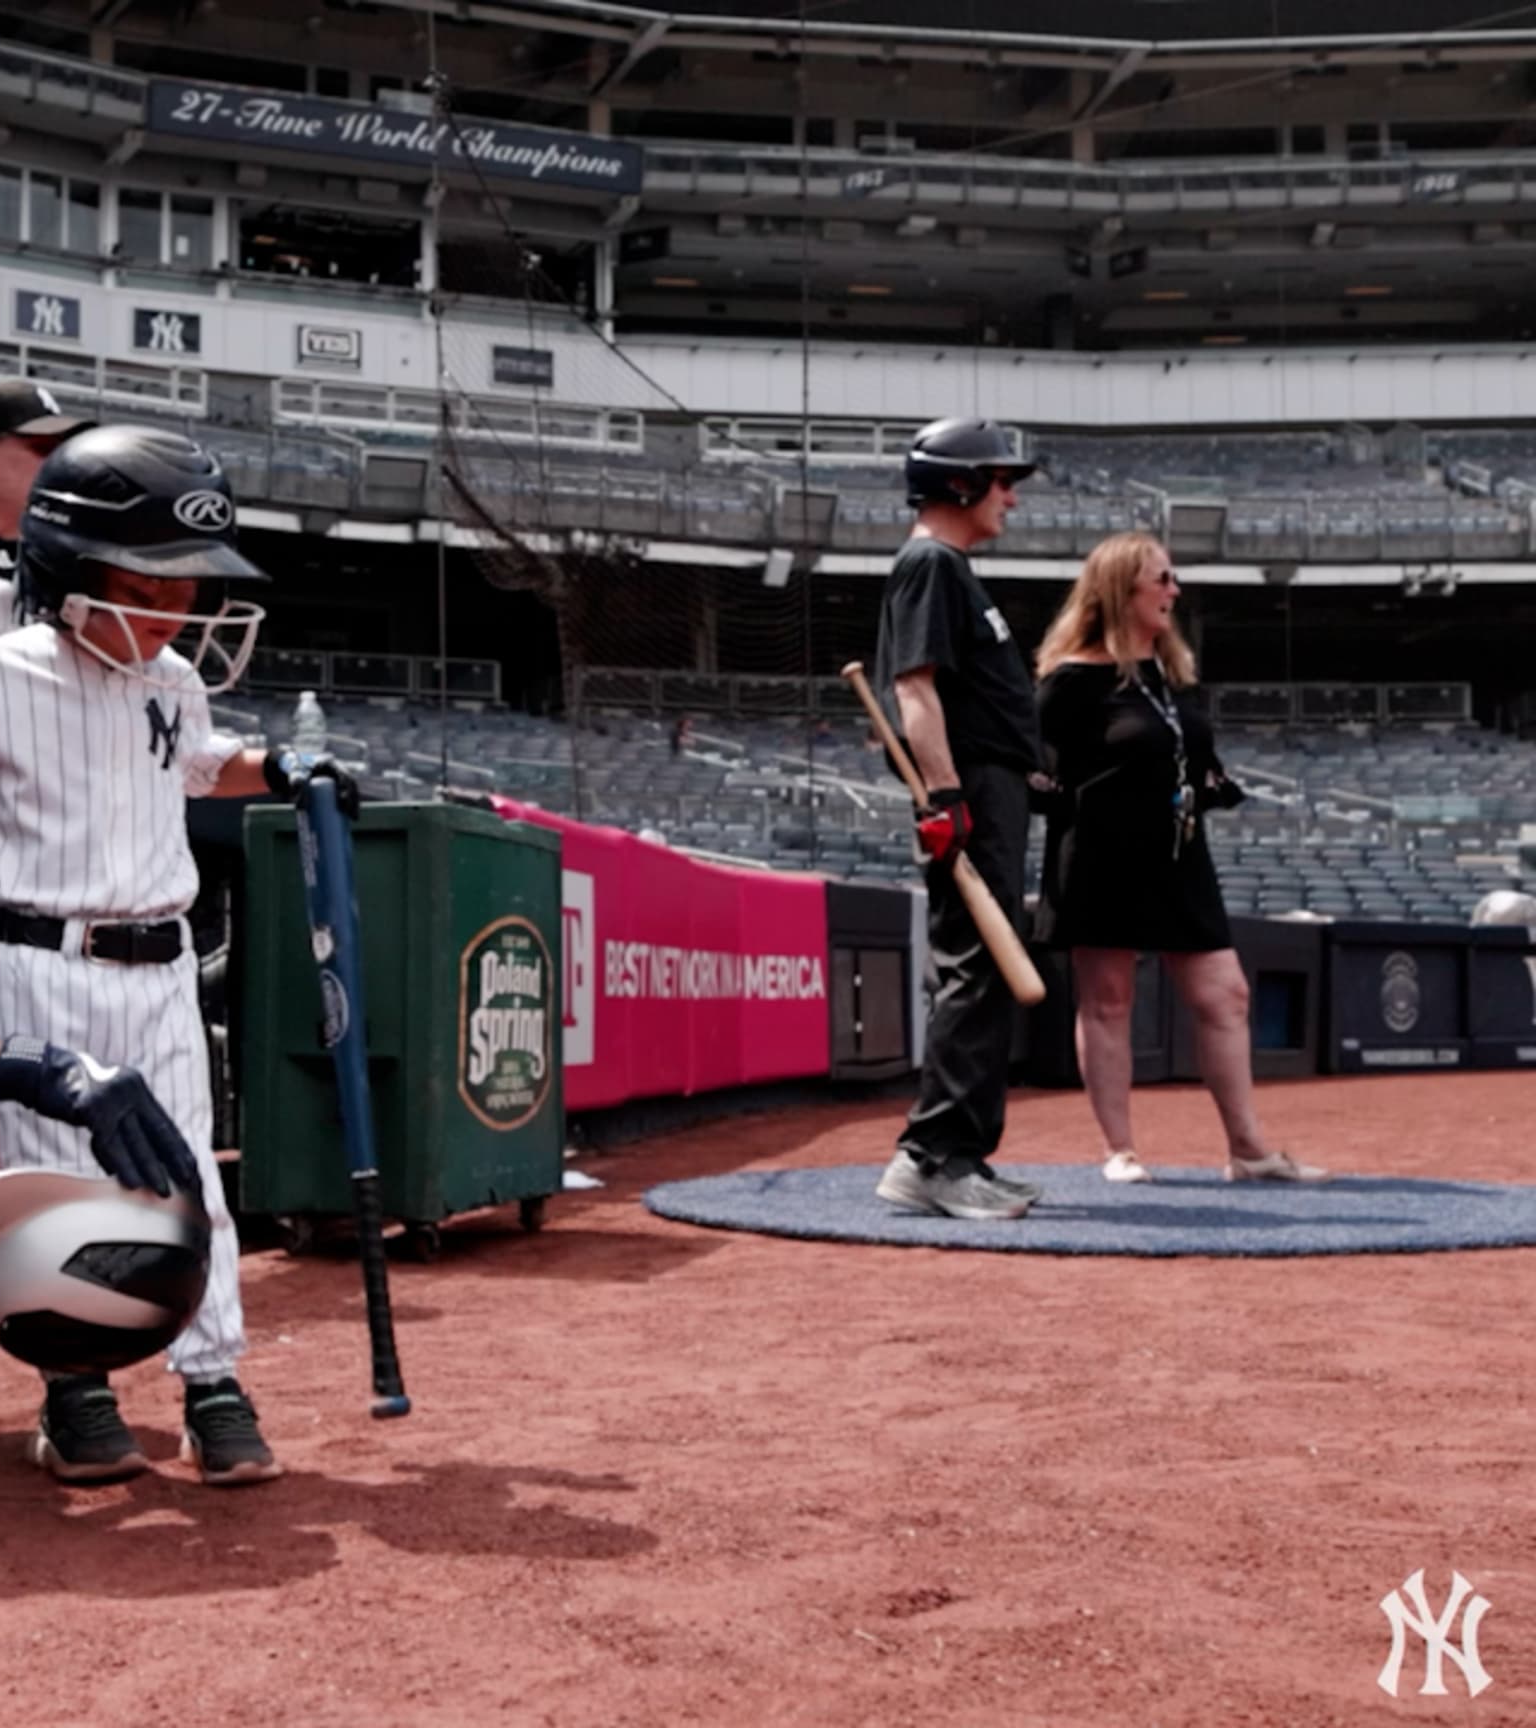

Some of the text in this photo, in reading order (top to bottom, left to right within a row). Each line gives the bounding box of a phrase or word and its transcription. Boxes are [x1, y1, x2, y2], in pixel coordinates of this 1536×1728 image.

[171, 89, 624, 177] 27-Time World Champions
[480, 950, 541, 1007] Poland
[605, 939, 649, 998] BEST
[736, 953, 825, 999] AMERICA
[468, 997, 545, 1086] Spring
